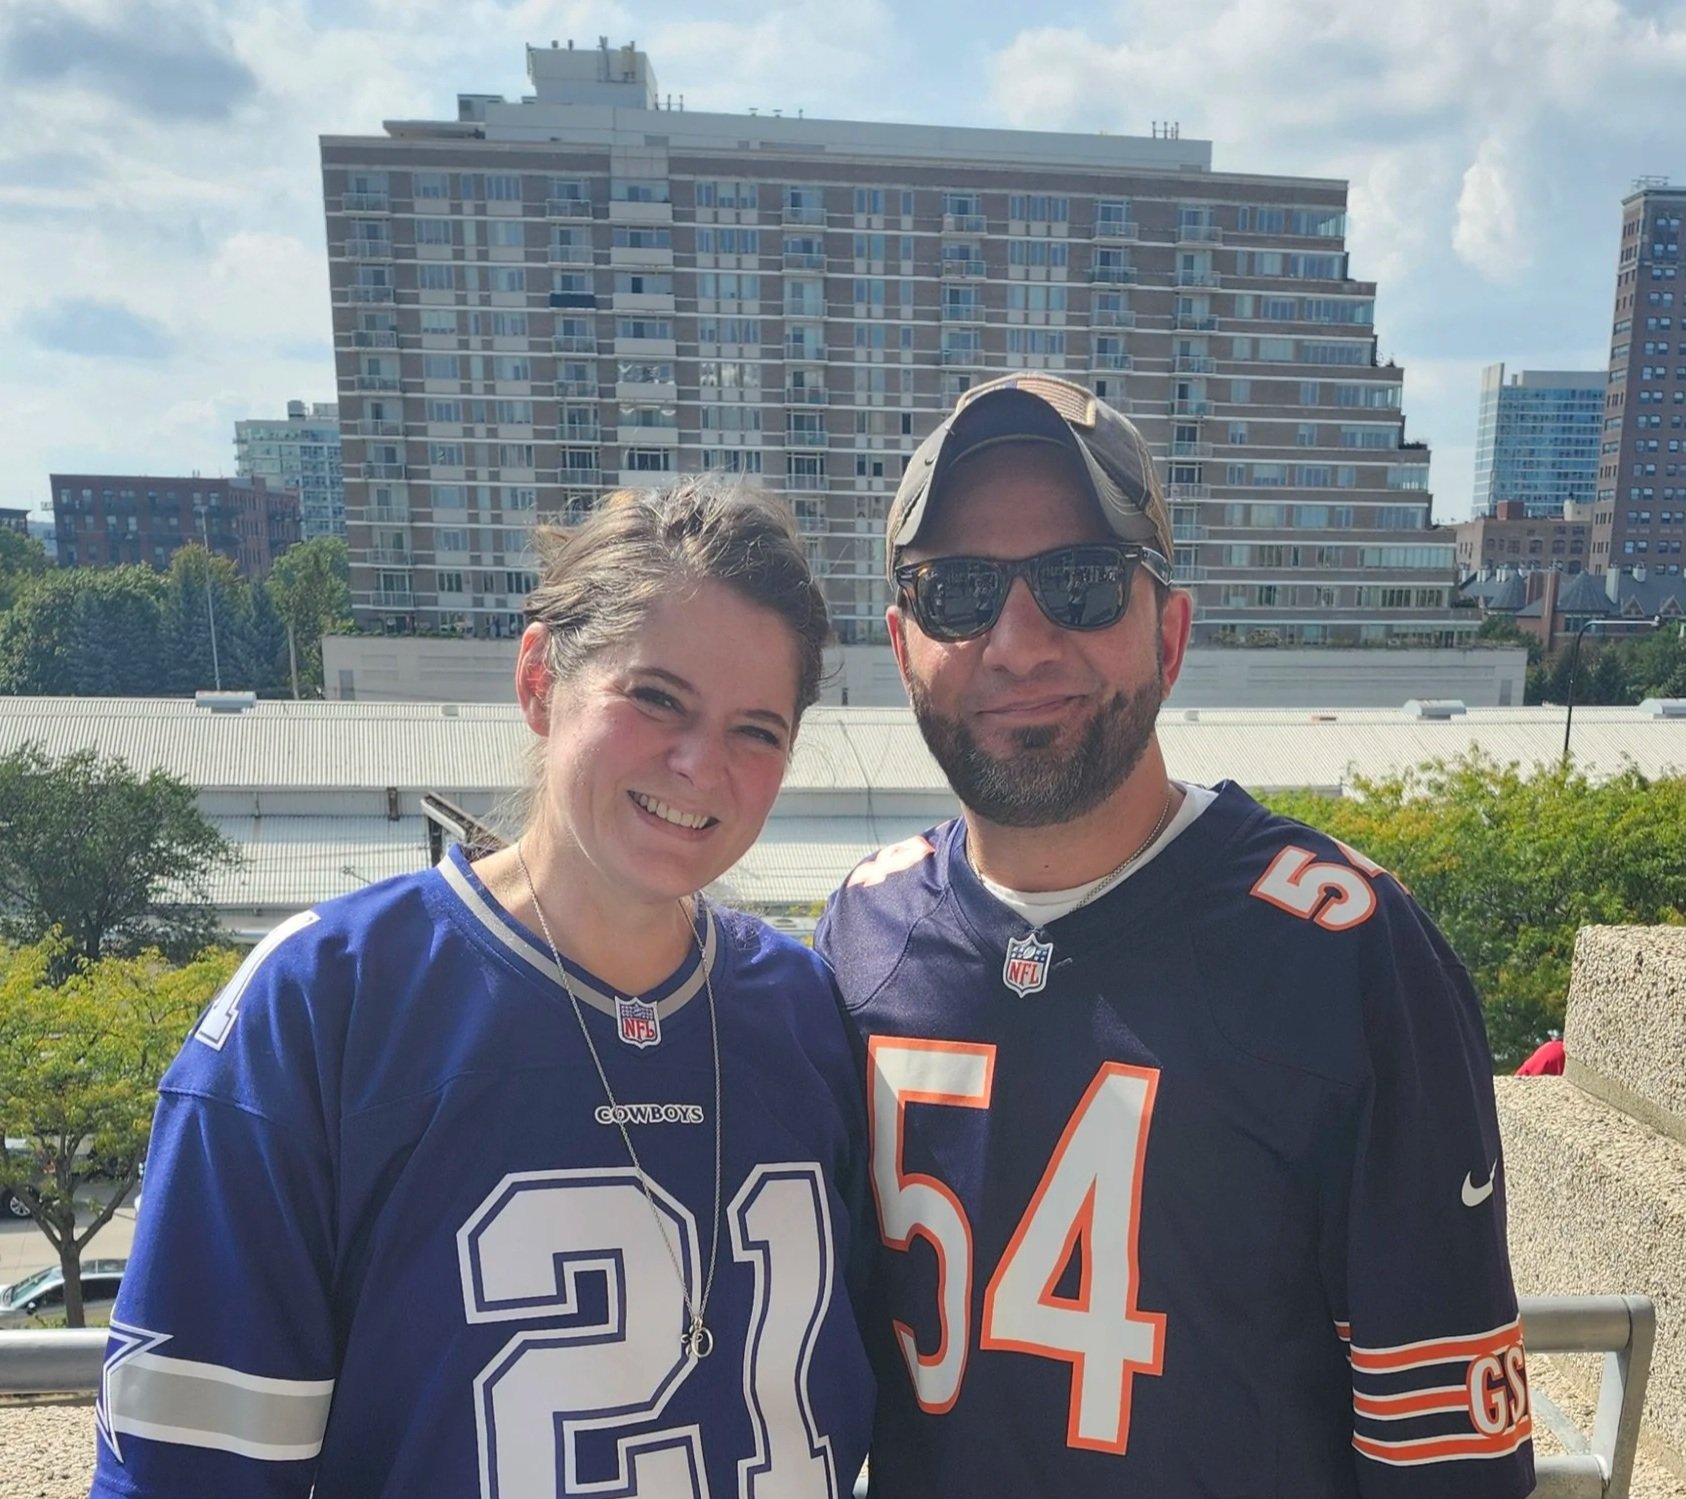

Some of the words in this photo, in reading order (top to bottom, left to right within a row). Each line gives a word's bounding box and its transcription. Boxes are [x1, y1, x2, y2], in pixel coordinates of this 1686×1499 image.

[1008, 961, 1040, 987] NFL
[623, 1017, 656, 1041] NFL
[594, 1103, 704, 1125] COWBOYS
[866, 1033, 1168, 1456] 54
[1465, 1342, 1530, 1437] GS
